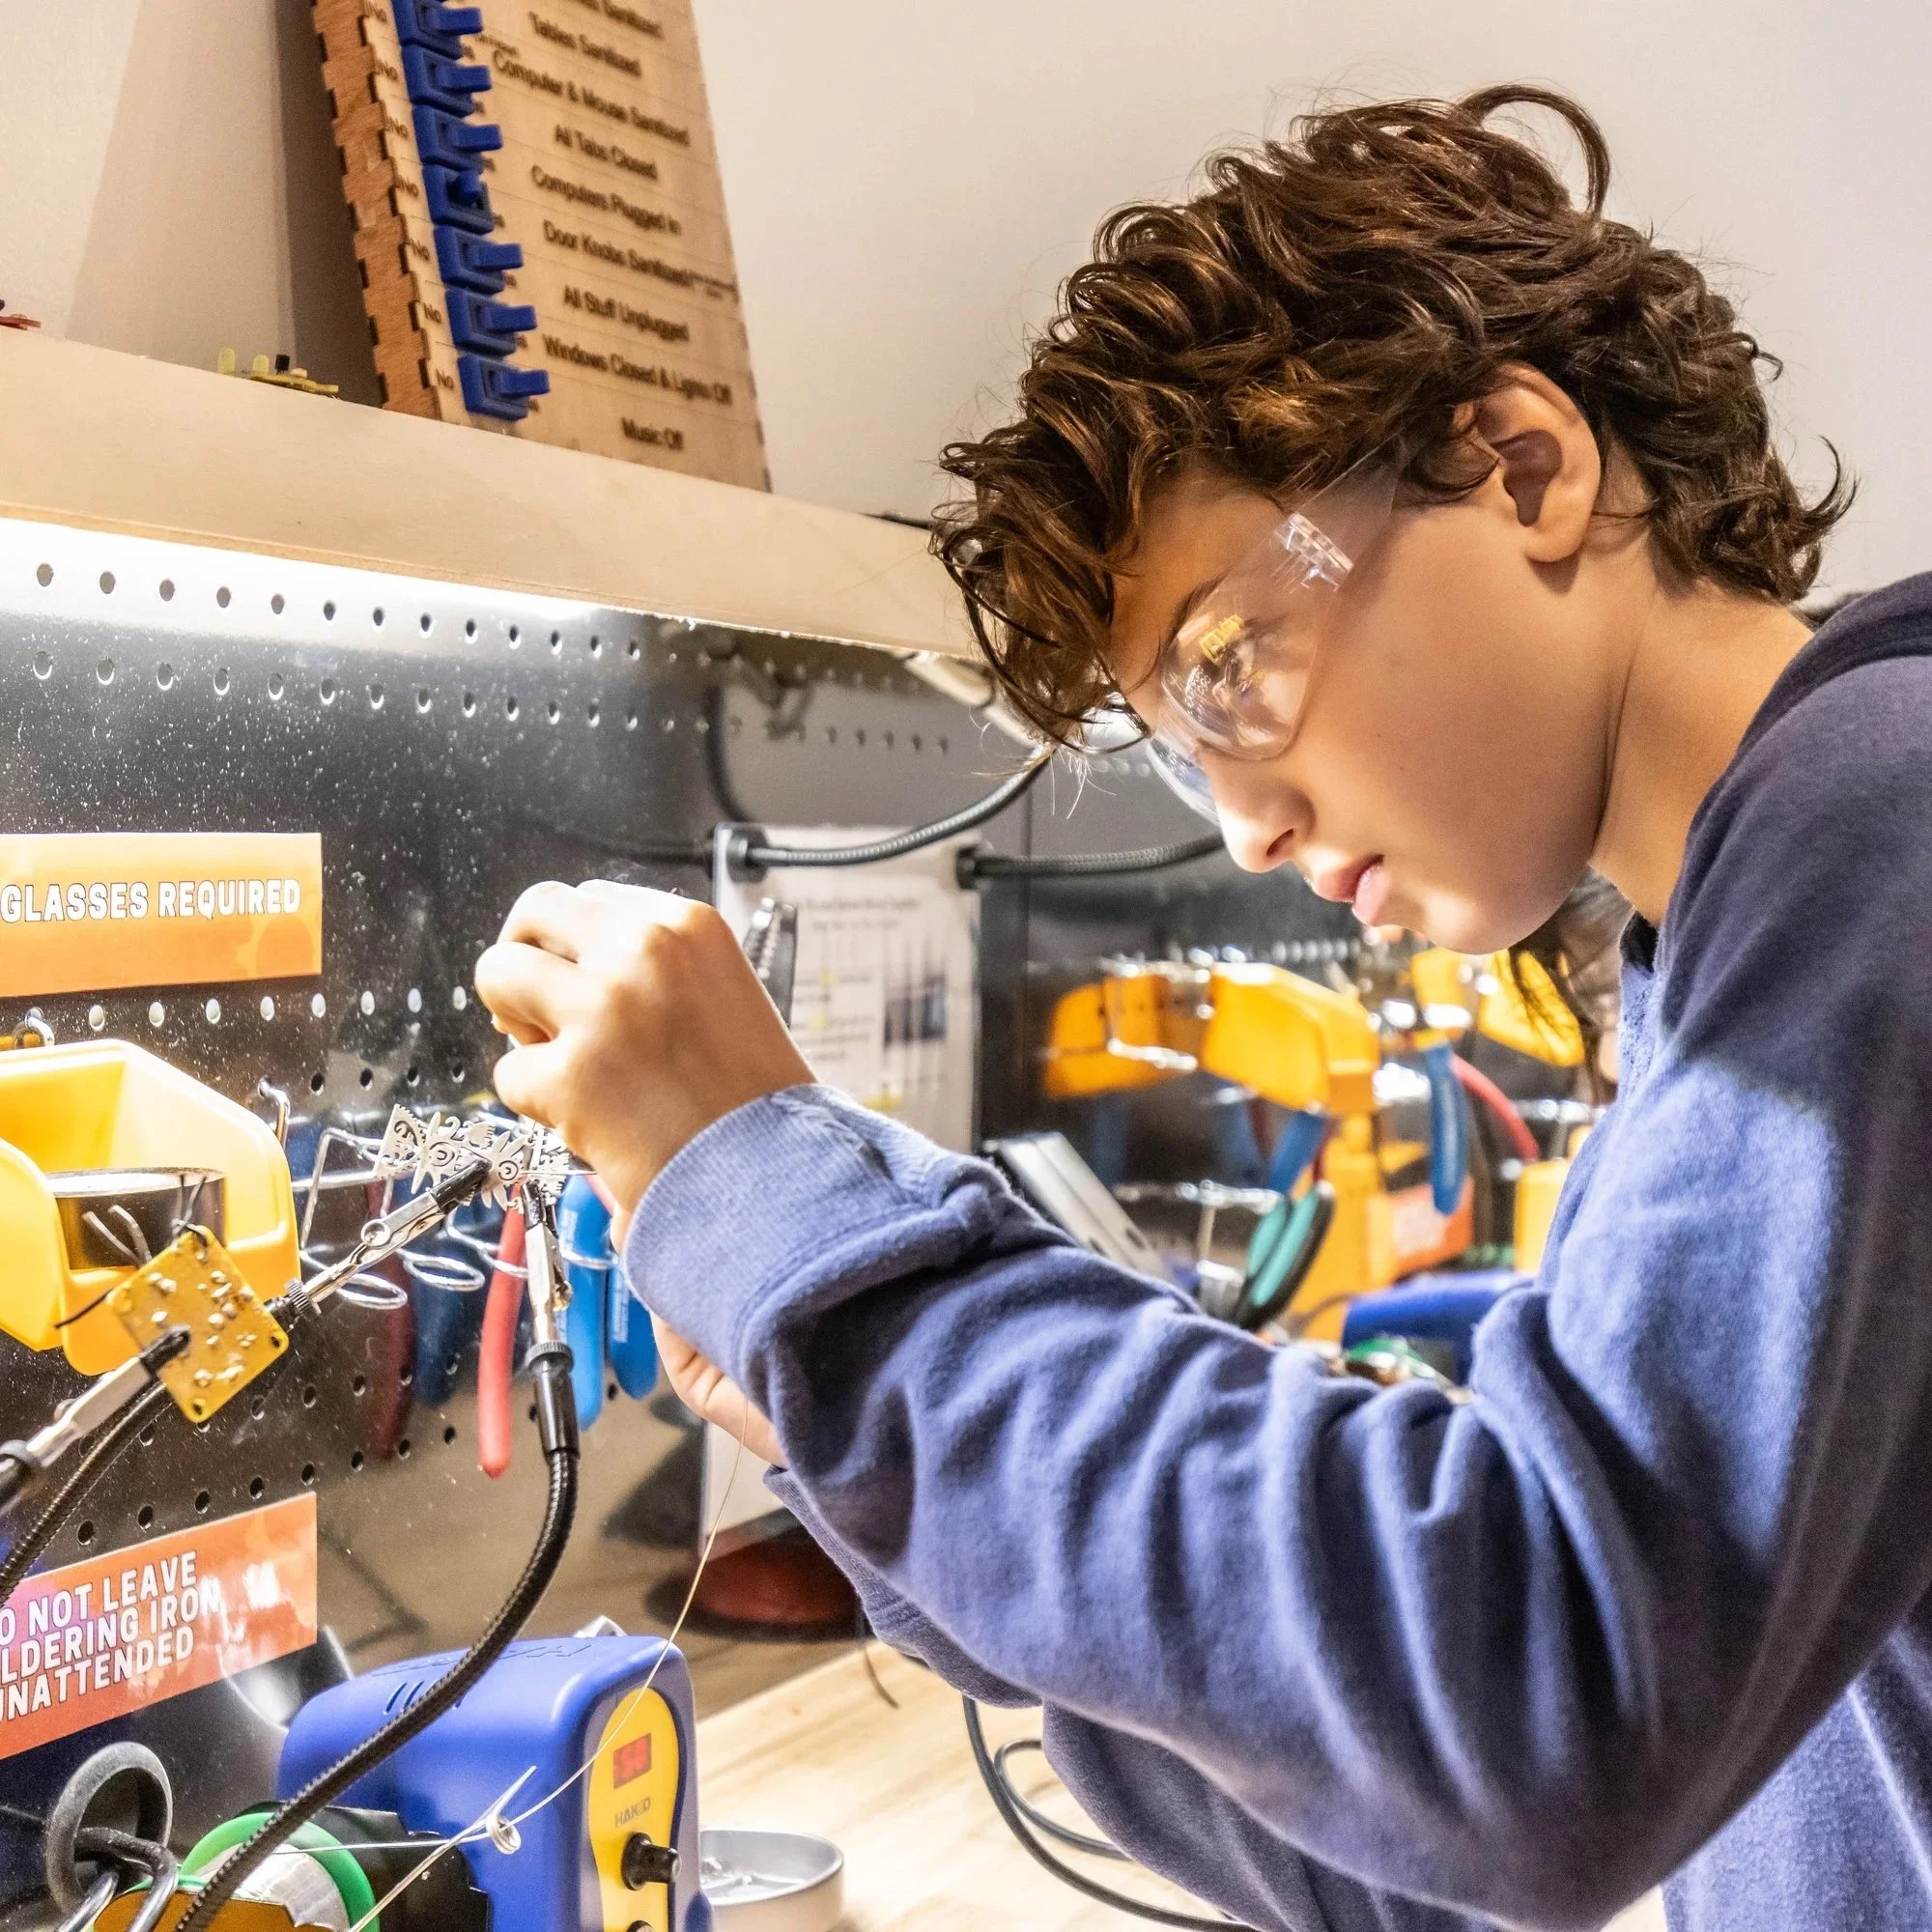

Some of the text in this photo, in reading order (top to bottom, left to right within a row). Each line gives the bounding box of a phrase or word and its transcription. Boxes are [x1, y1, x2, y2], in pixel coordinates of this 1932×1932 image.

[493, 49, 564, 97] Computer
[581, 85, 629, 123] Mouse
[554, 124, 573, 148] All
[611, 145, 658, 182] Closed
[530, 163, 610, 212] Computers
[611, 192, 667, 231] Plugged
[410, 238, 431, 261] No
[543, 218, 579, 251] Door
[581, 233, 627, 267] Knobs
[423, 300, 442, 324] No
[564, 284, 690, 341] All Stuff Unplugged
[436, 369, 455, 391] No
[542, 332, 610, 372] Windows
[611, 354, 658, 385] Closed
[621, 416, 662, 446] Music
[0, 879, 301, 923] GLASSES REQUIRED
[28, 1582, 93, 1637] NOT
[102, 1549, 197, 1613] LEAVE
[0, 1576, 222, 1685] LDERING IRON
[0, 1625, 194, 1722] NATTENDED
